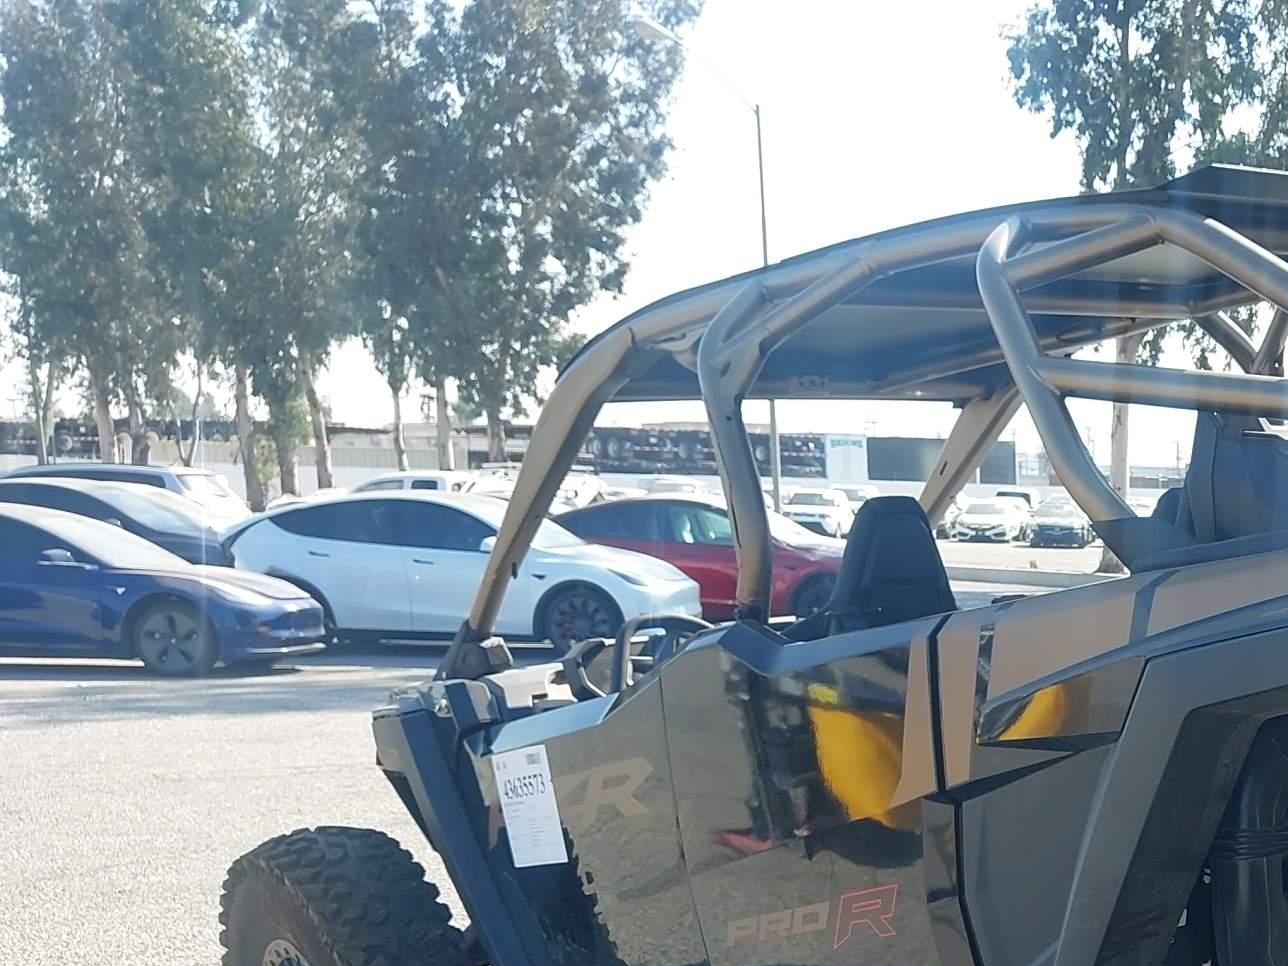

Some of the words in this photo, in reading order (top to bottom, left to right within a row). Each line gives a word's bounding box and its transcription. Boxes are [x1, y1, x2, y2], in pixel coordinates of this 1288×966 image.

[504, 773, 546, 800] 43635573
[727, 902, 830, 946] PRO
[833, 884, 898, 950] R
